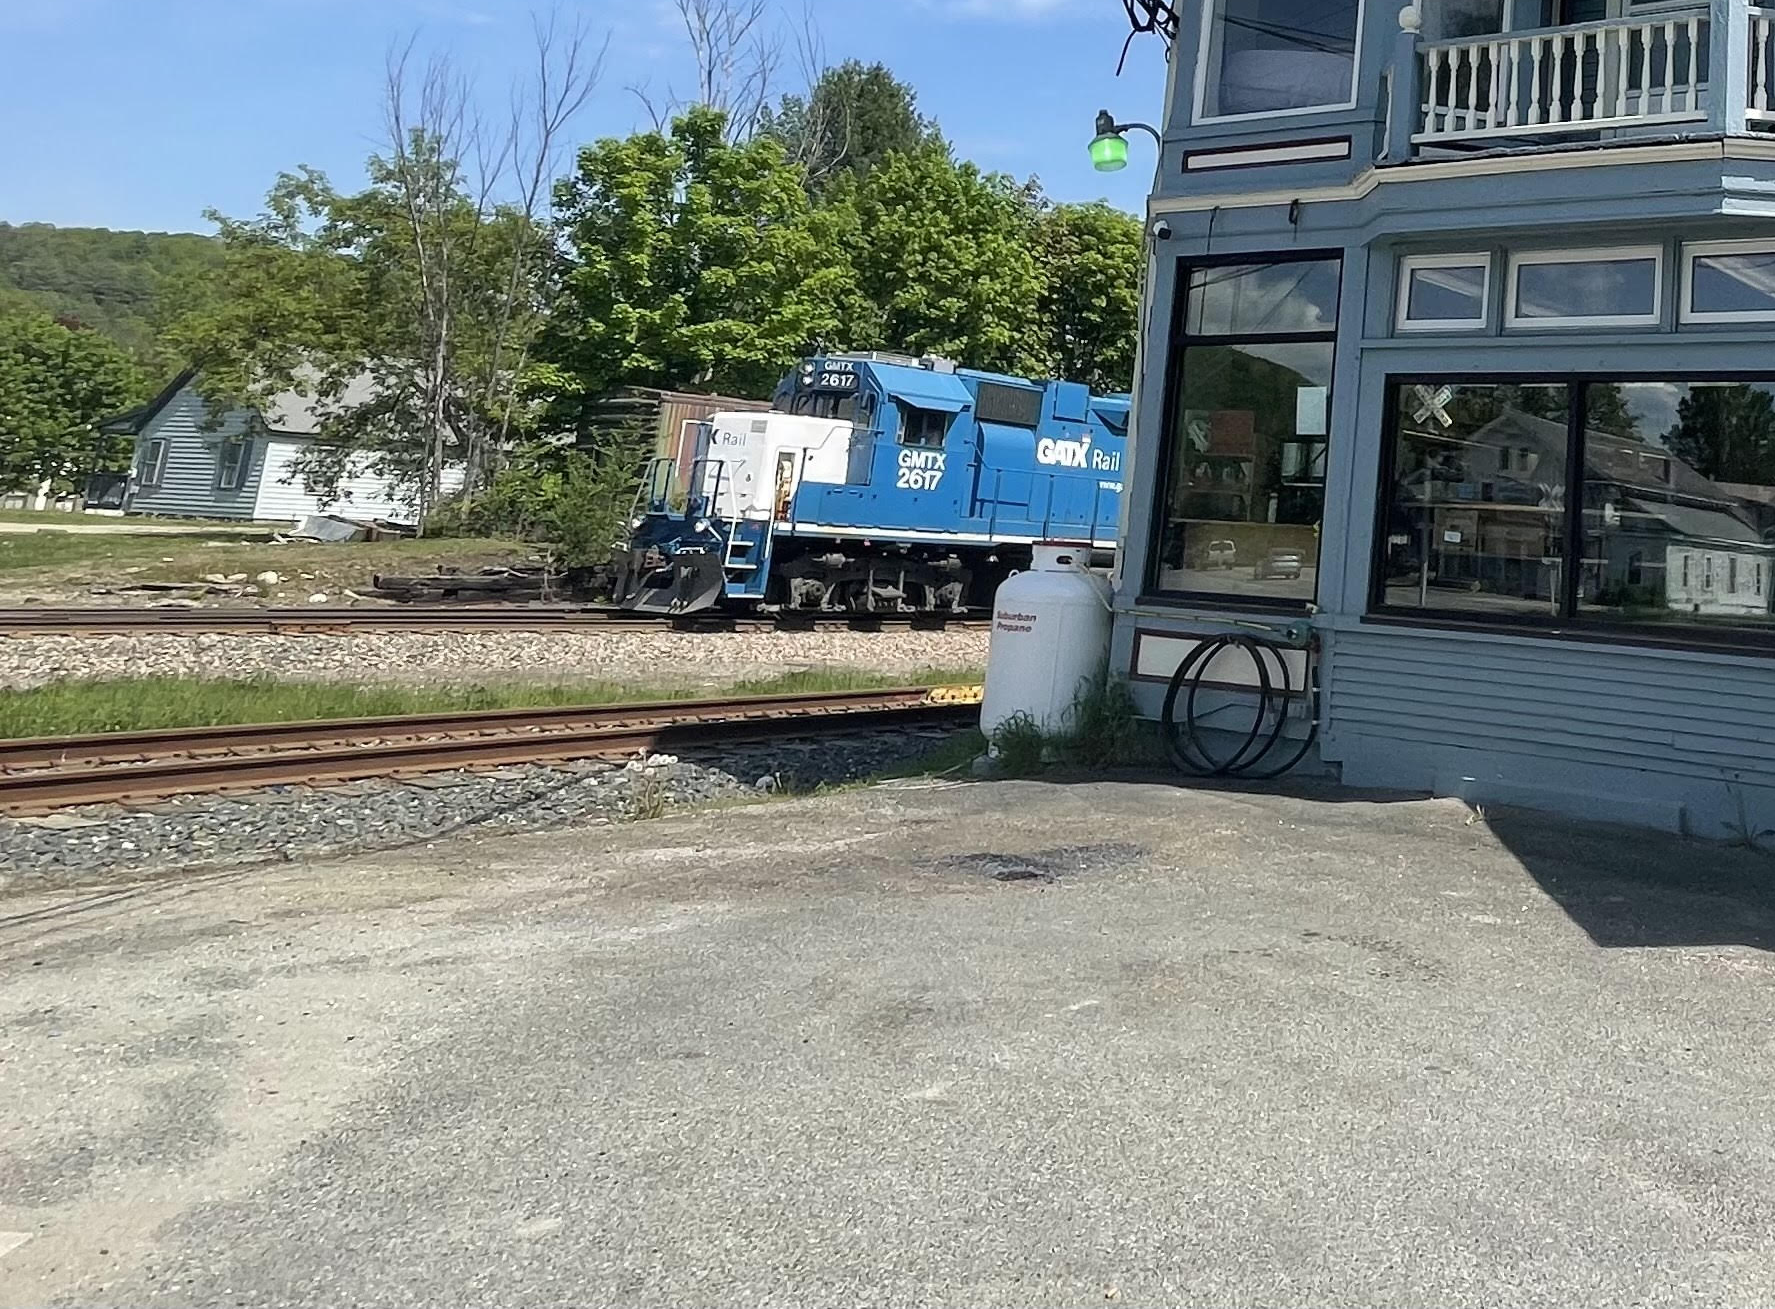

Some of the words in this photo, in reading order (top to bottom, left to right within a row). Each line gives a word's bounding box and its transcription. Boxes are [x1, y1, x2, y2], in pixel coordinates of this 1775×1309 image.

[824, 361, 855, 371] GMTX
[820, 373, 855, 386] 2617
[722, 432, 747, 446] Rail
[897, 449, 947, 470] GMTX
[1037, 437, 1091, 468] GATX
[1092, 448, 1120, 471] Rail
[896, 468, 943, 490] 2617
